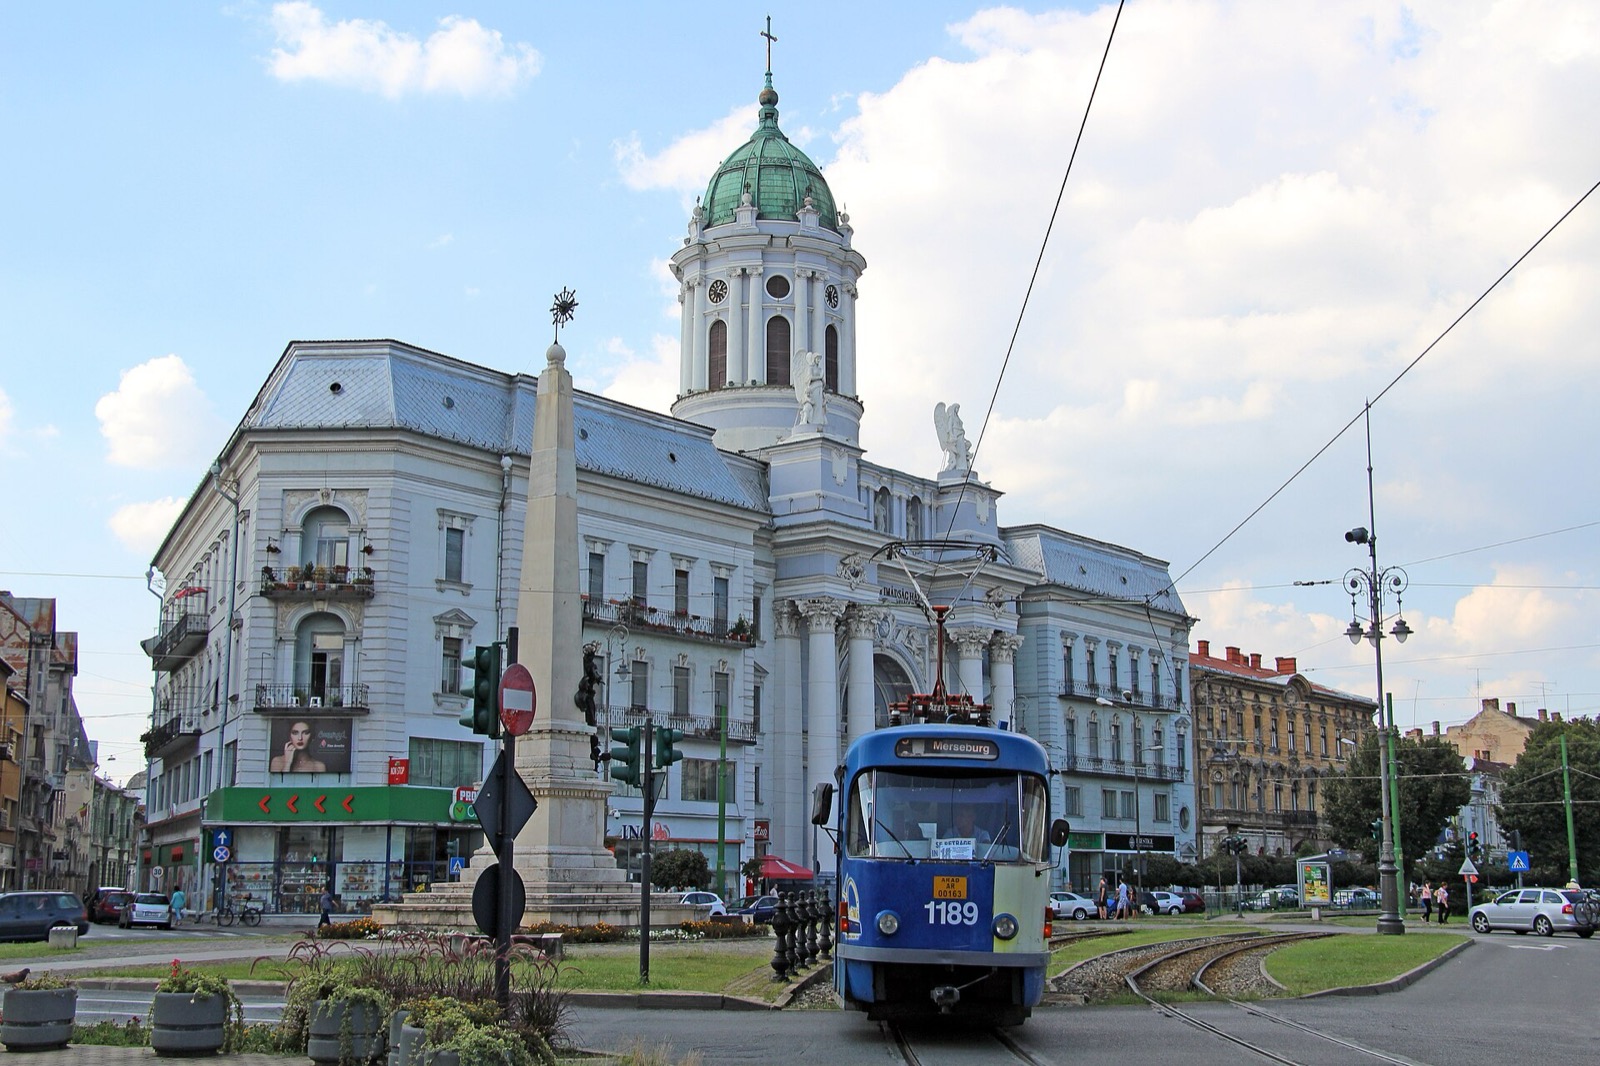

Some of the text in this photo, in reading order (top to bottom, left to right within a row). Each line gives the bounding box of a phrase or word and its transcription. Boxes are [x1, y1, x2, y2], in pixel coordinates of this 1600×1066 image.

[933, 741, 990, 755] Merseburg
[931, 849, 939, 857] IN
[938, 890, 962, 898] 00163
[924, 901, 979, 926] 1189
